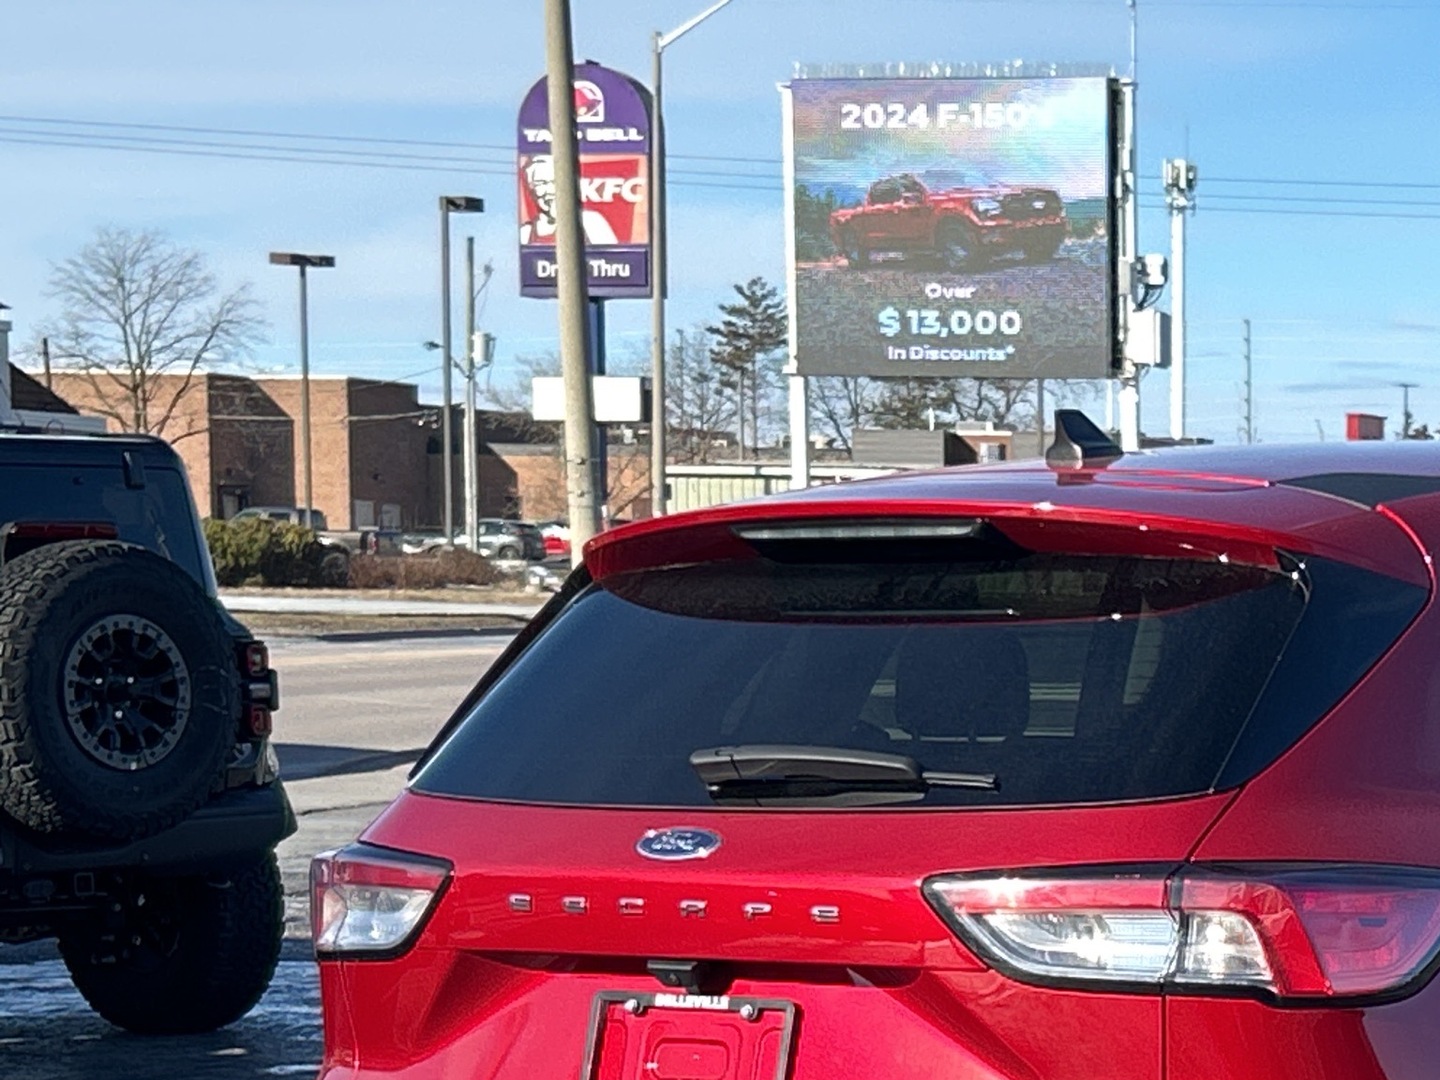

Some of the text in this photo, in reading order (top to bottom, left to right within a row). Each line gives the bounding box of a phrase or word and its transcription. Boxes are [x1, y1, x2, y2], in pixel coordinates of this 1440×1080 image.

[840, 103, 930, 129] 2024
[580, 177, 648, 203] KFC
[589, 260, 631, 278] Thru
[924, 282, 977, 299] Over
[906, 309, 1023, 338] 13,000
